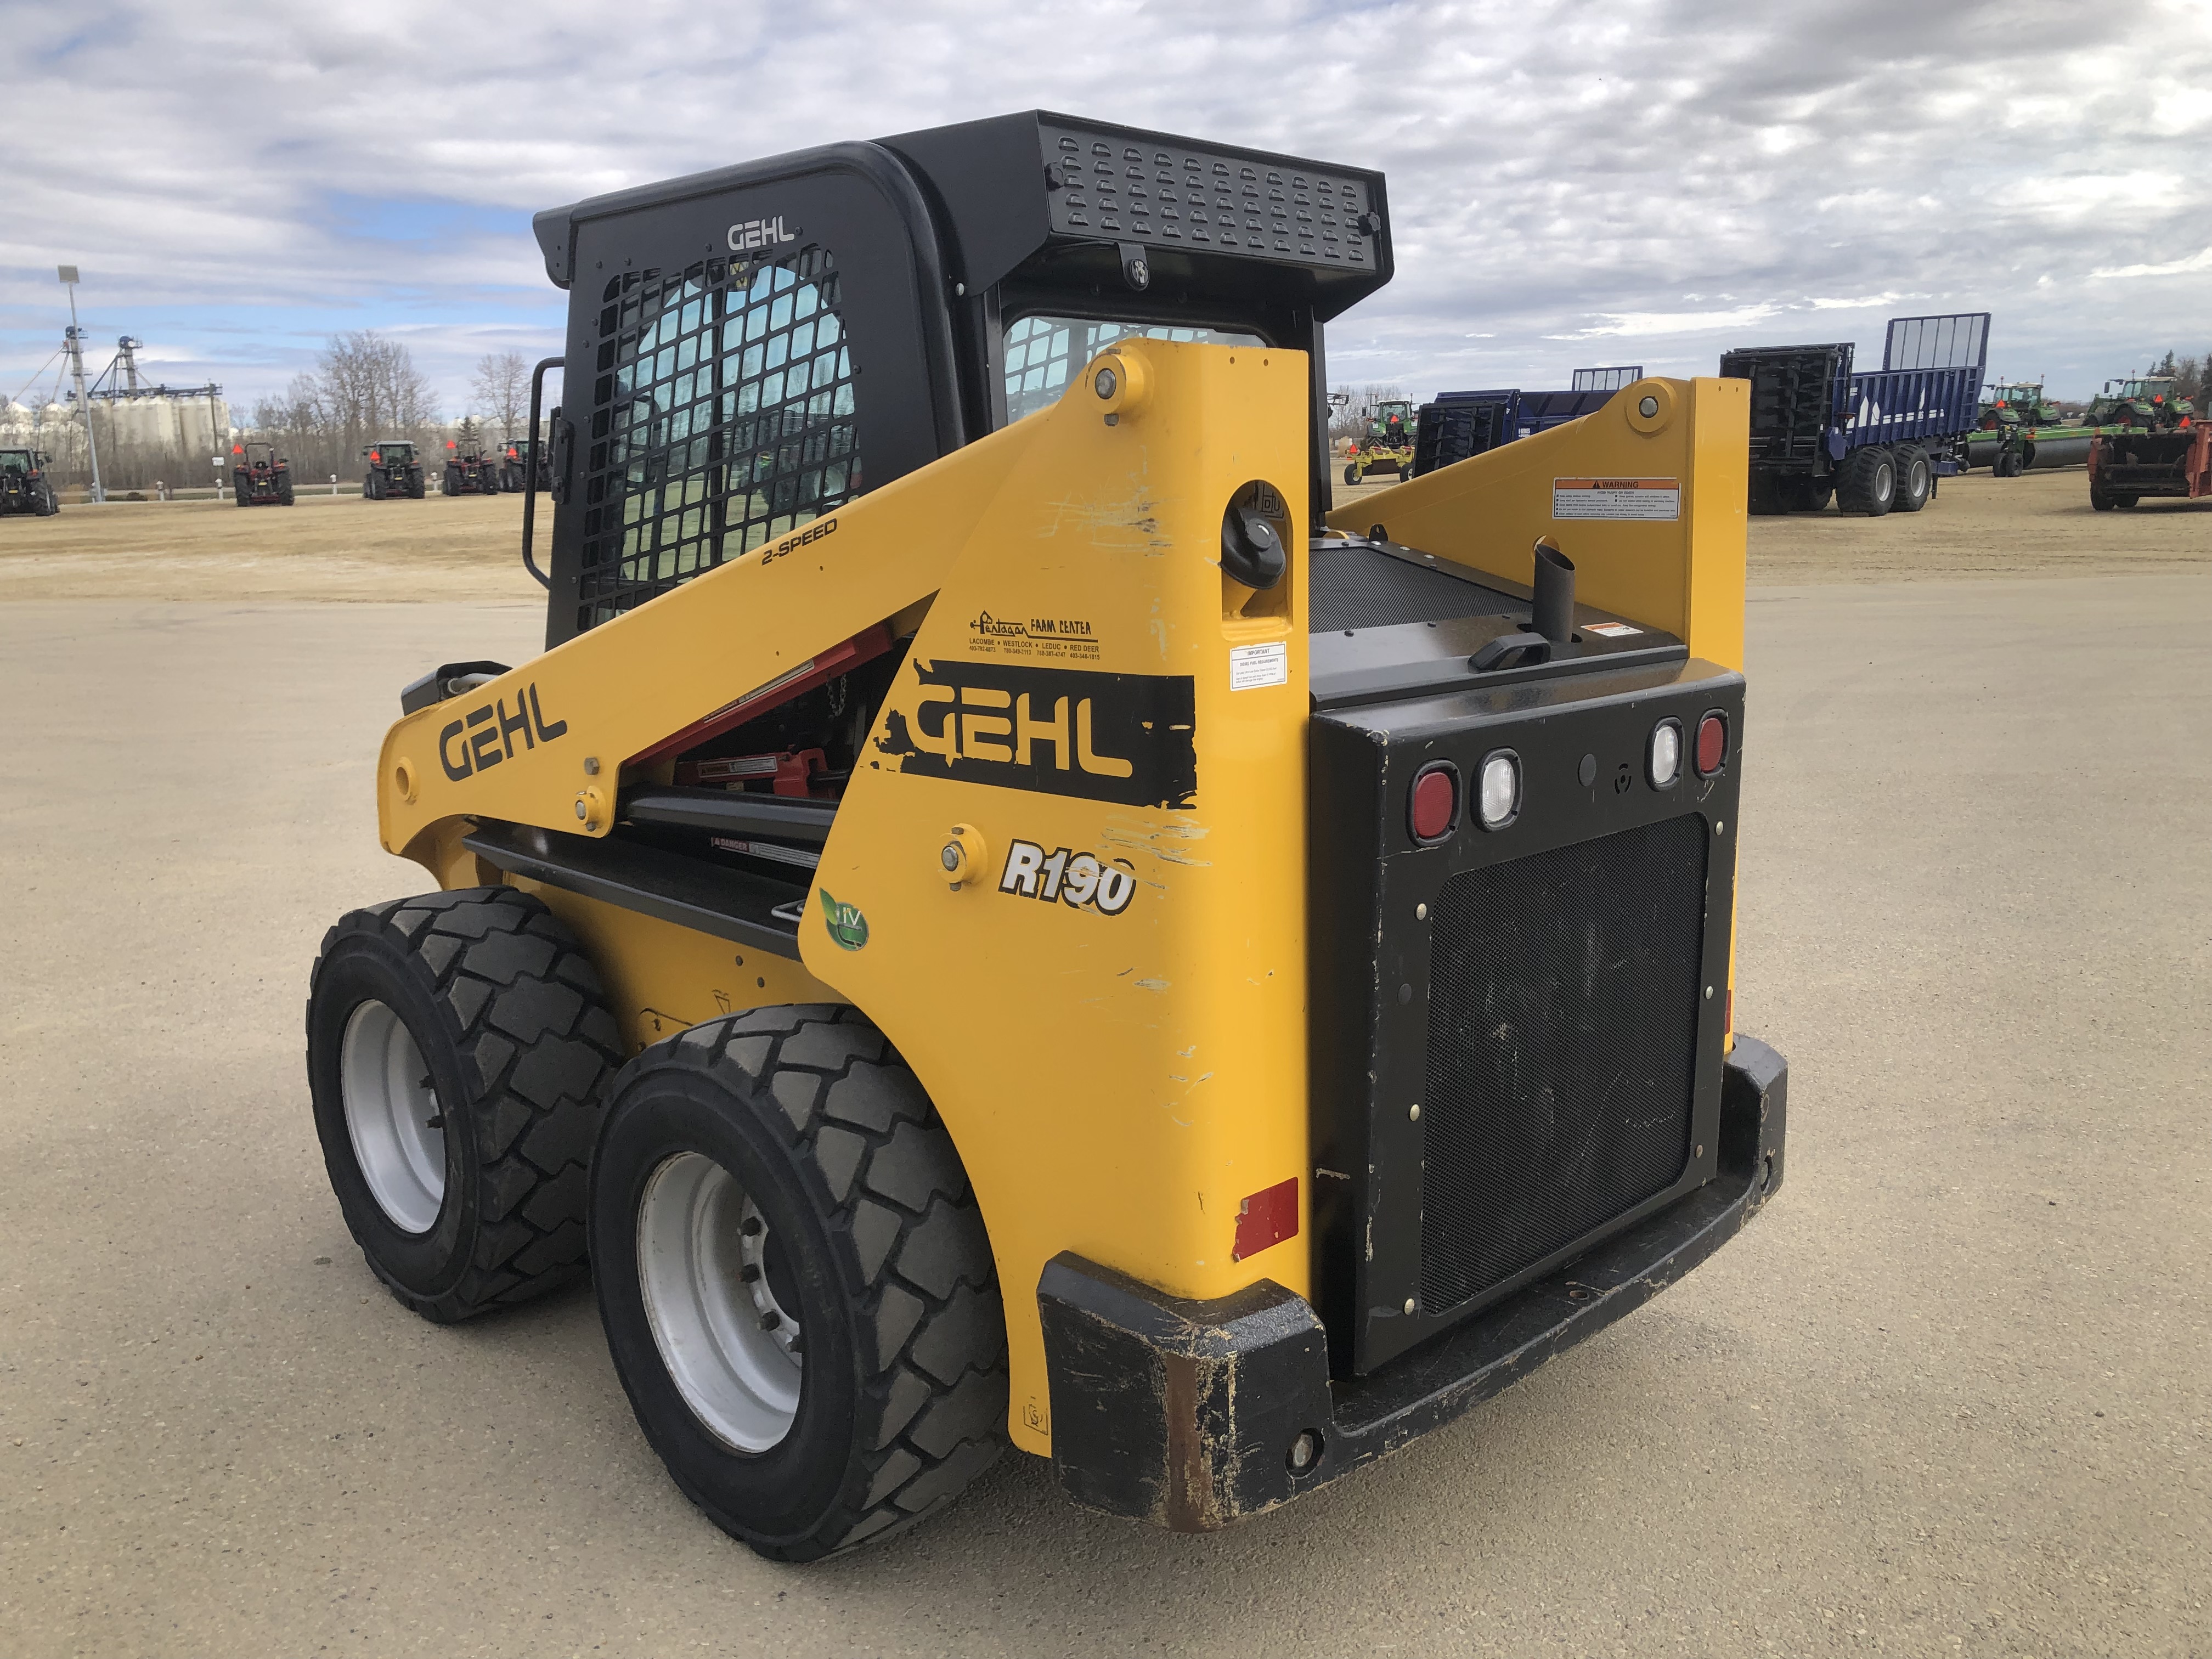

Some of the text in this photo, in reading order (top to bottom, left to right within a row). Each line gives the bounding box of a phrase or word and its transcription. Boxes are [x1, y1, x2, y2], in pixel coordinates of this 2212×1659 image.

[727, 216, 794, 250] GEHL
[762, 518, 837, 566] 2-SPEED
[1003, 640, 1033, 648] WESTLOCK
[1031, 618, 1057, 633] FARM
[1059, 620, 1092, 635] CENTER
[439, 682, 567, 782] GEHL
[904, 684, 1133, 778] GEHL
[720, 838, 748, 850] DANGER
[998, 838, 1136, 916] R190
